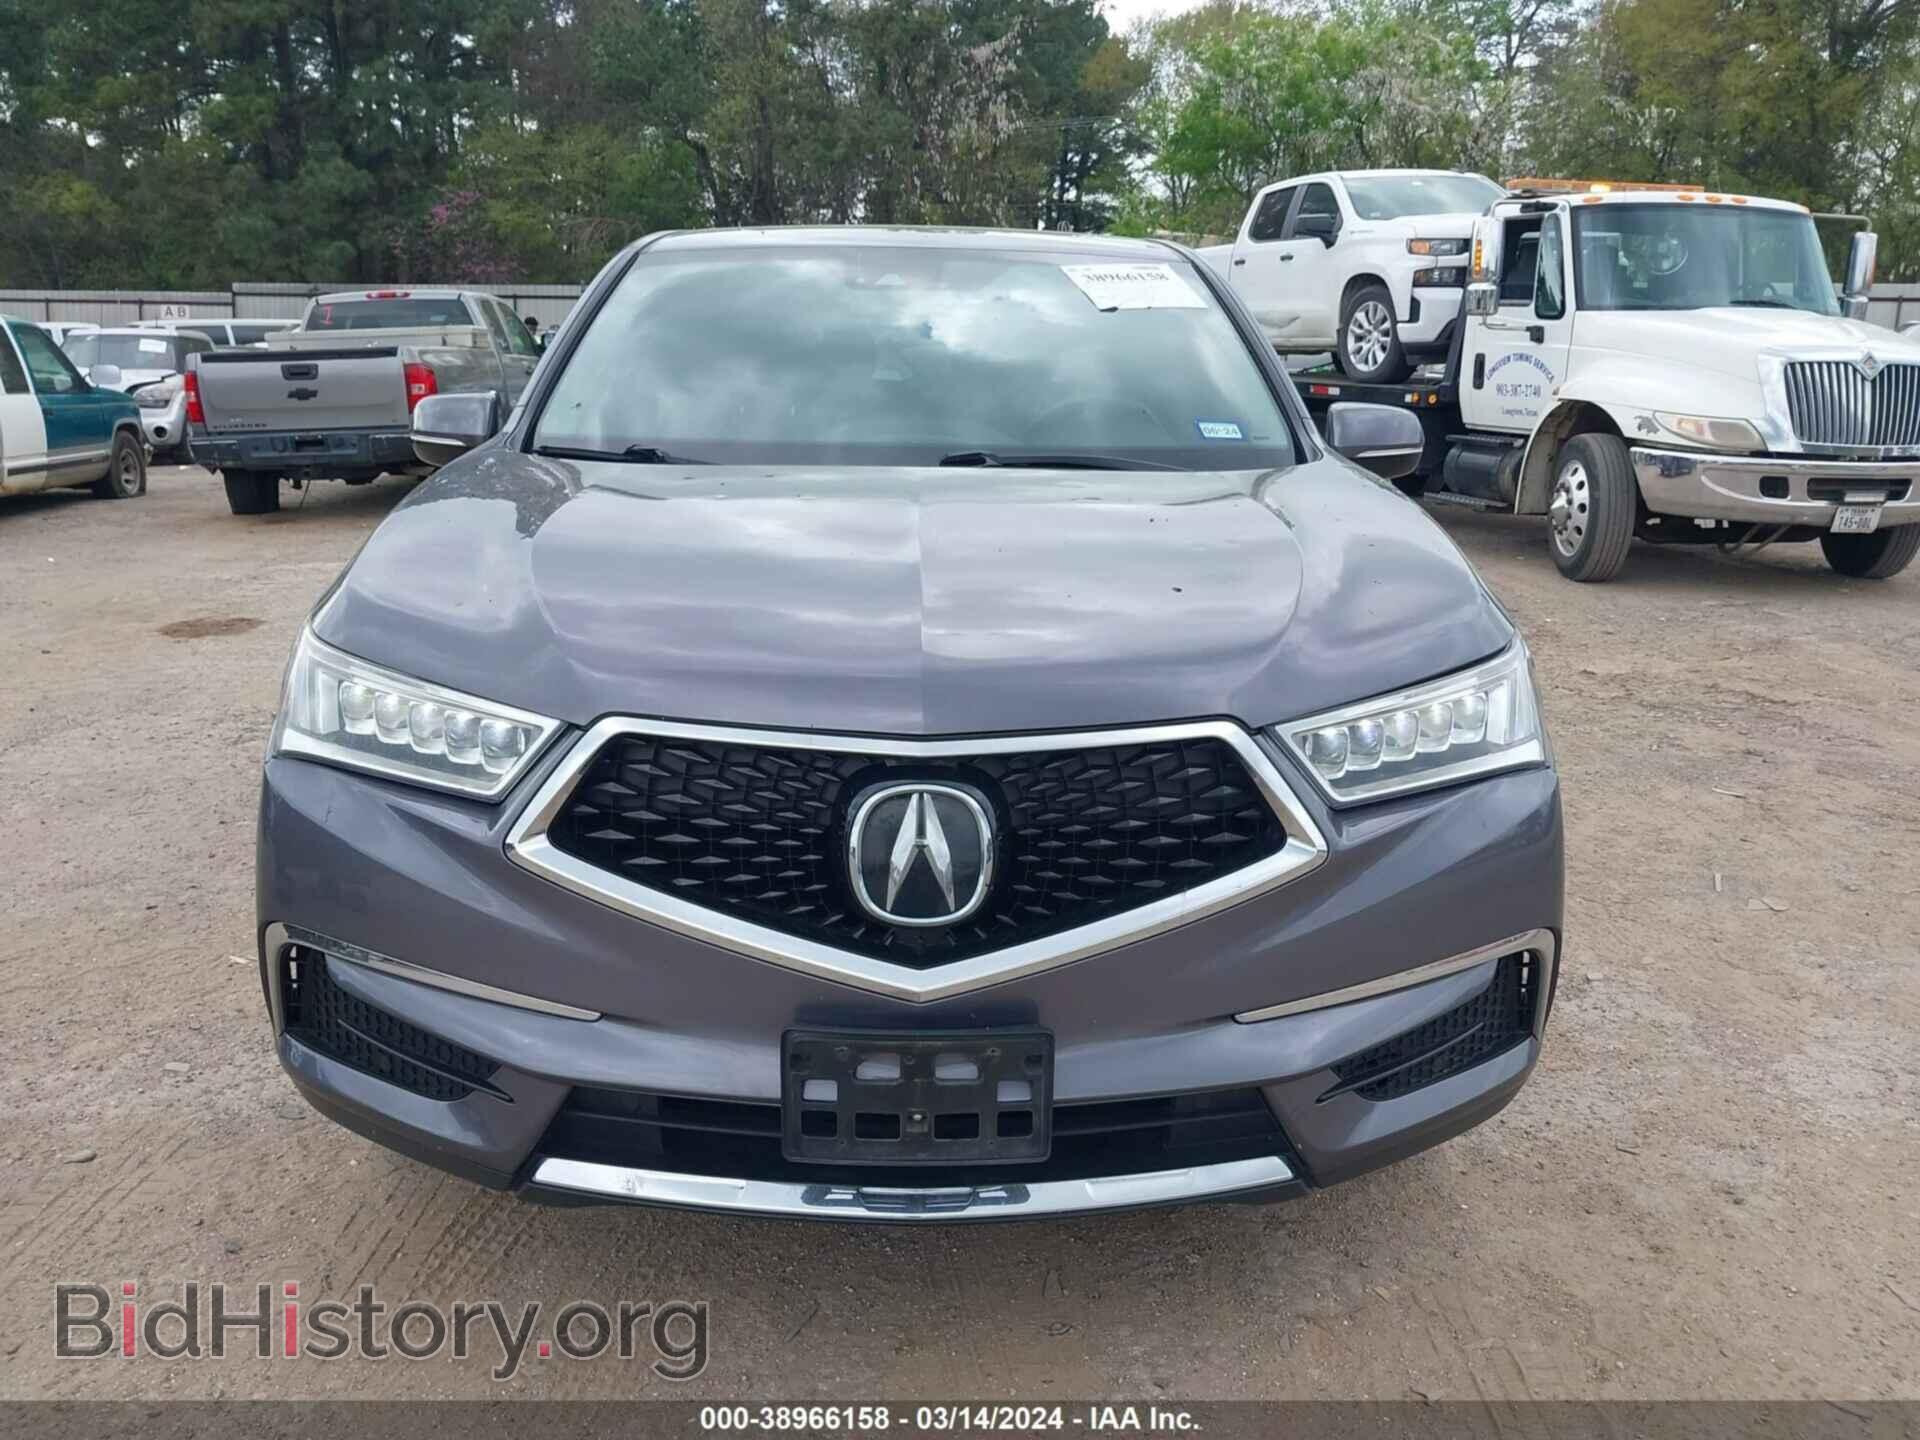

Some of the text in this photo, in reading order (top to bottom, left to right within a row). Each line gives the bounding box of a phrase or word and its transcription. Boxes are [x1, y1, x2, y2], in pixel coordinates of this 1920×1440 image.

[164, 305, 186, 318] A B
[1512, 352, 1534, 365] TOWING
